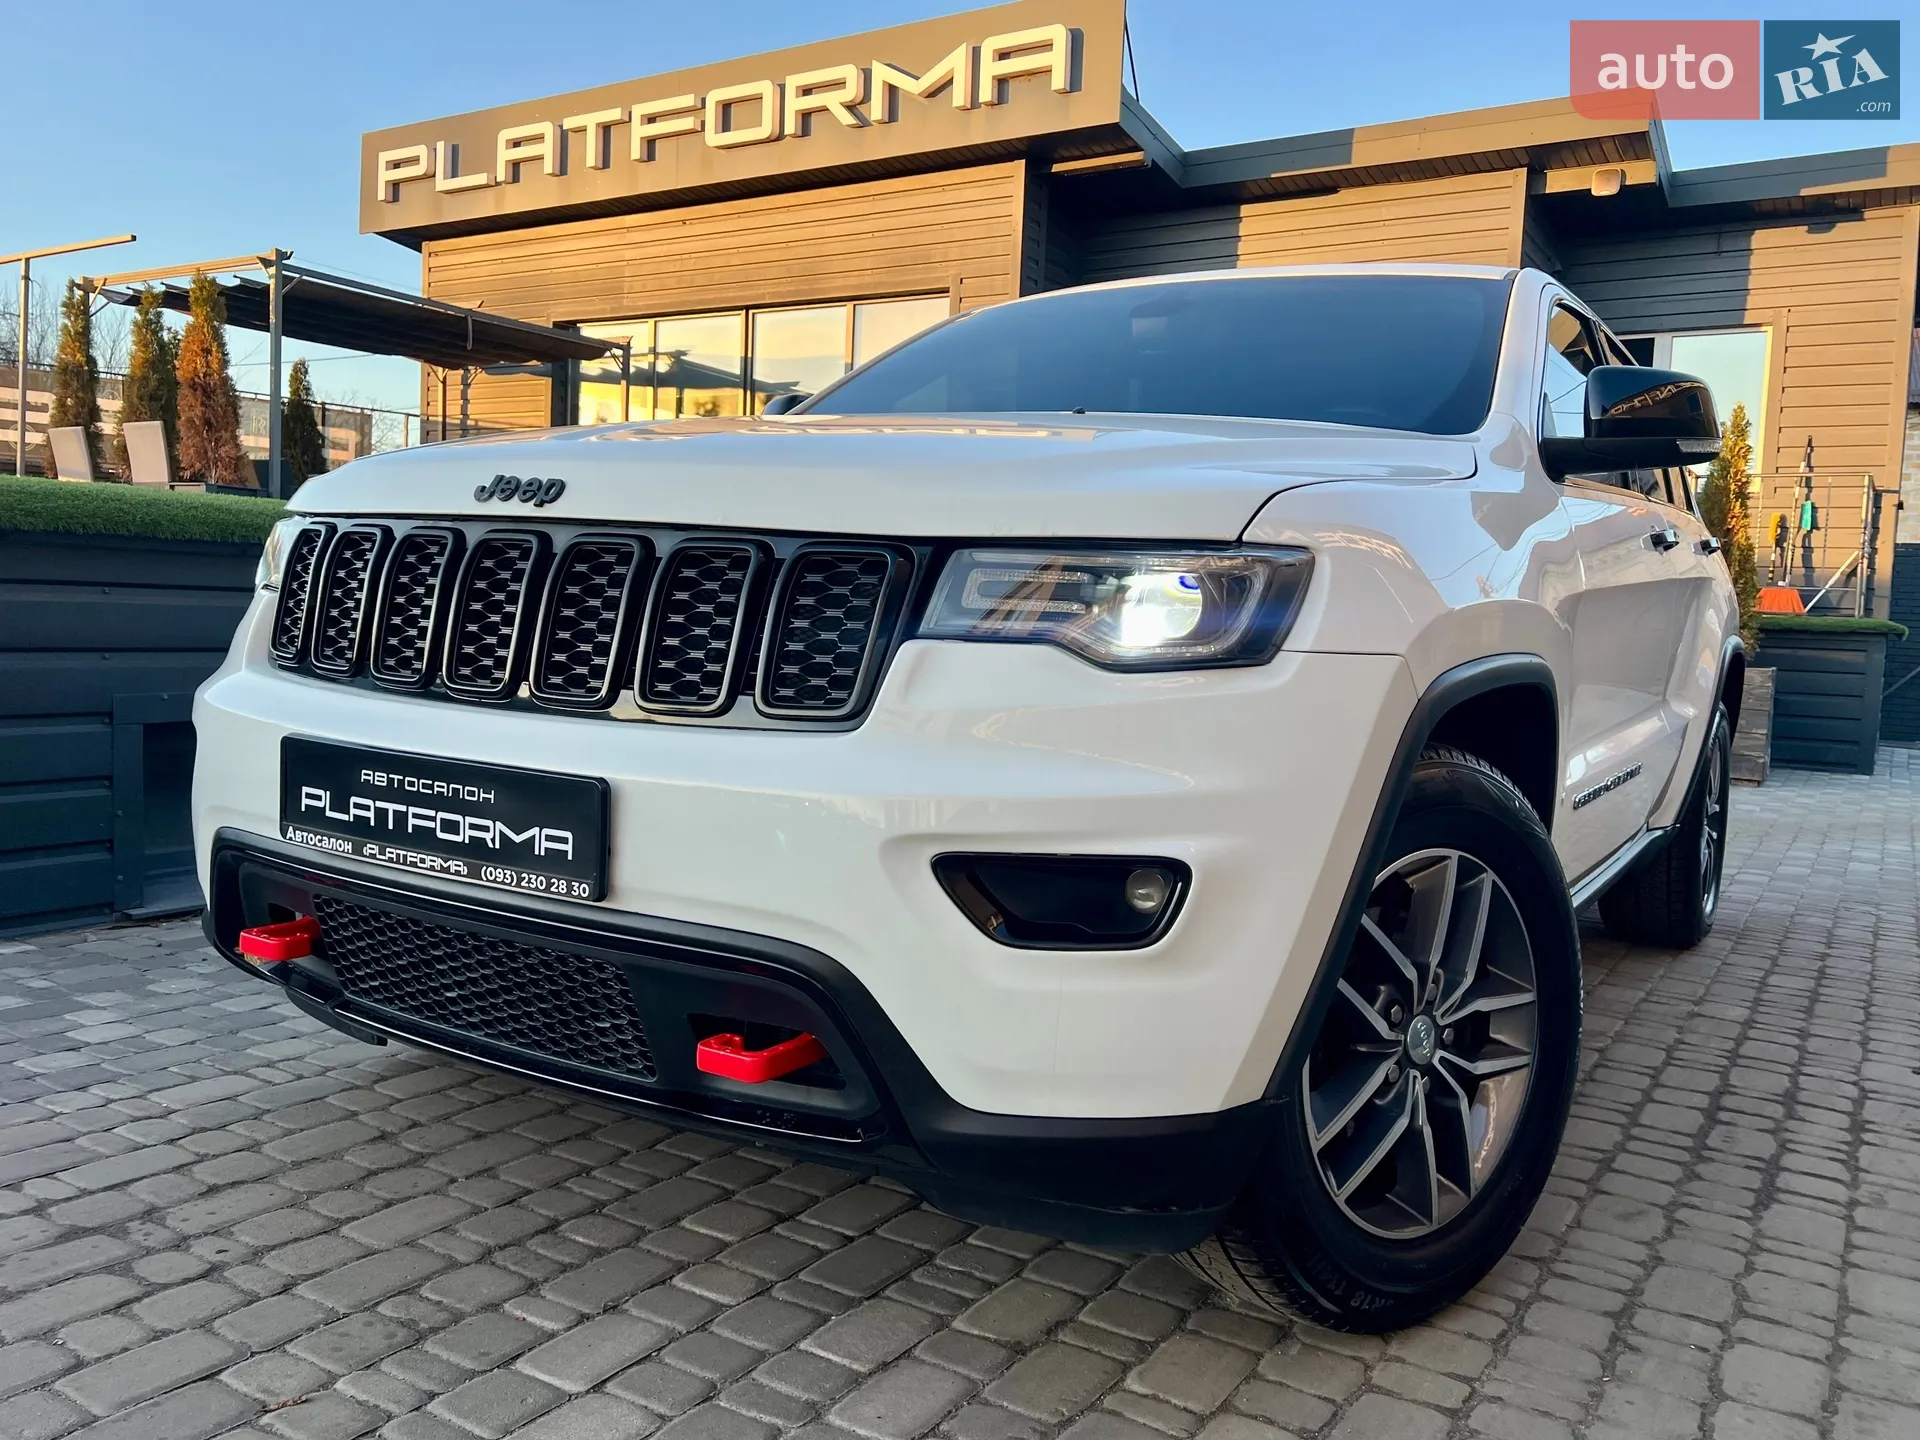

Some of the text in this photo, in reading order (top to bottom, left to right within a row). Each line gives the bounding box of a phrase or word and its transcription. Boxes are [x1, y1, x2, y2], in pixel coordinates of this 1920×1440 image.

[377, 23, 1073, 203] PLATFORMA
[473, 474, 567, 508] Jeep
[360, 769, 496, 804] АВТОСАЛОН
[300, 786, 575, 861] PLATFORMA
[286, 825, 353, 854] Автосалон
[480, 865, 518, 887] (093)
[520, 873, 547, 890] 230
[550, 878, 567, 894] 28
[571, 882, 590, 898] 30
